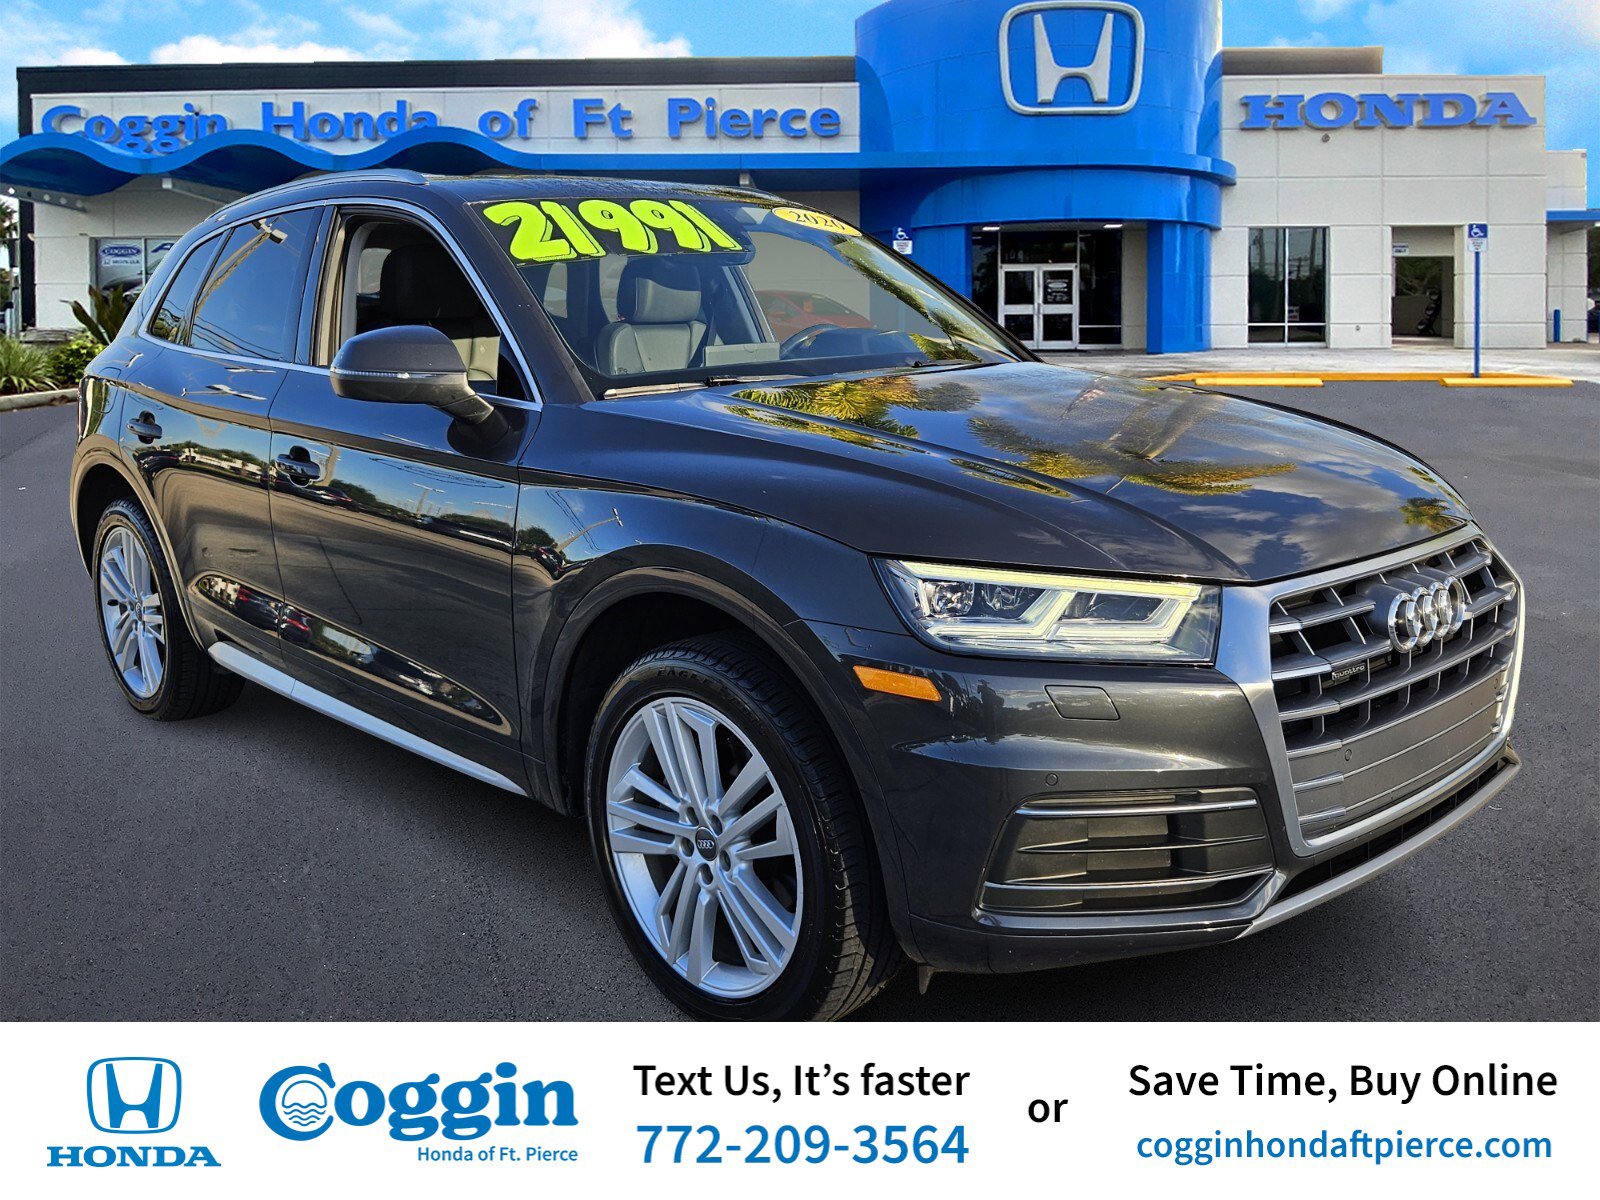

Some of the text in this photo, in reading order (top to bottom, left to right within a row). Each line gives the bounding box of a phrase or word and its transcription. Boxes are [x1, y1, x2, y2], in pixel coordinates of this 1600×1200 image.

[41, 97, 842, 154] Coggin Honda of Ft Pierce
[1241, 92, 1537, 130] HONDA
[482, 199, 743, 263] 21991
[788, 210, 846, 231] 2020
